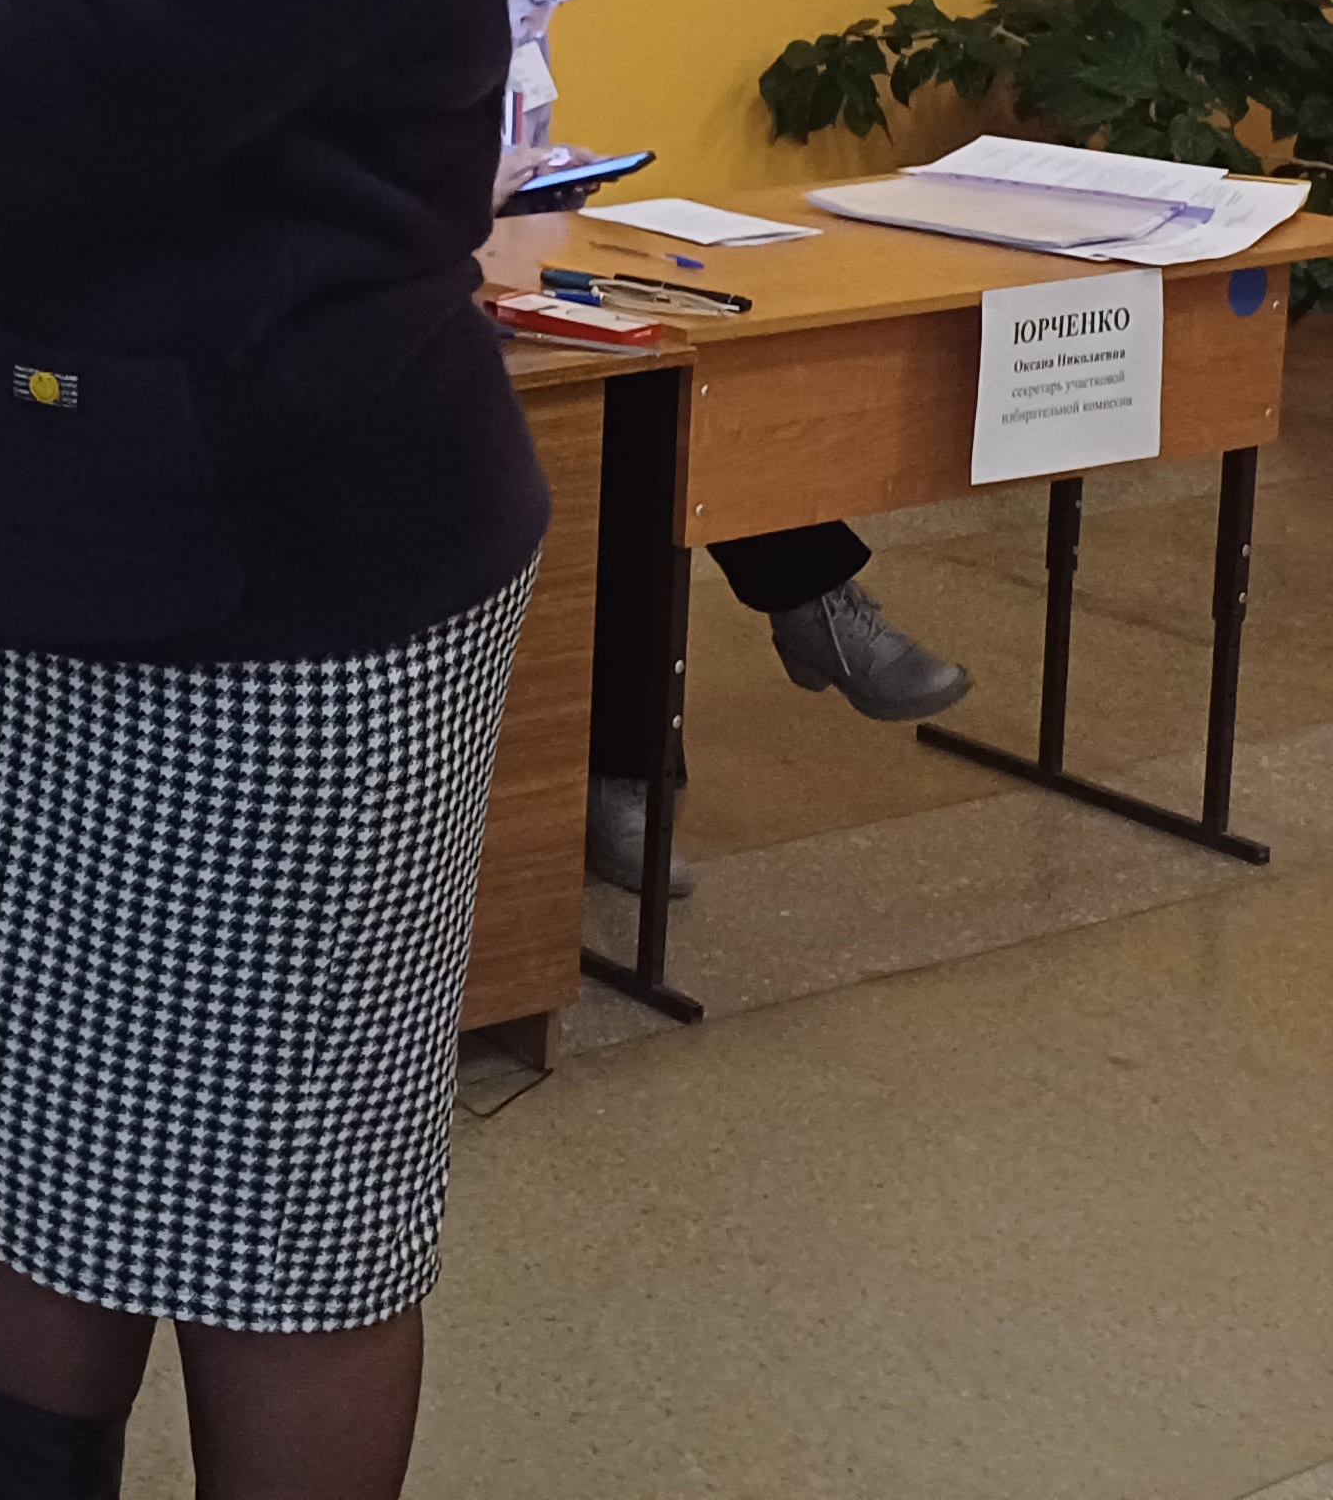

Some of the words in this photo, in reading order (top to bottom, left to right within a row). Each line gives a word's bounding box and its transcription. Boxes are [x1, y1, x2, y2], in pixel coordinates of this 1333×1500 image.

[1013, 307, 1131, 345] ЮРЧЕНКО
[1013, 359, 1054, 374] Оксана
[1057, 349, 1126, 368] Николаевна
[1011, 381, 1063, 400] секретарь
[1064, 370, 1125, 394] участковой
[1082, 396, 1133, 412] комиссии
